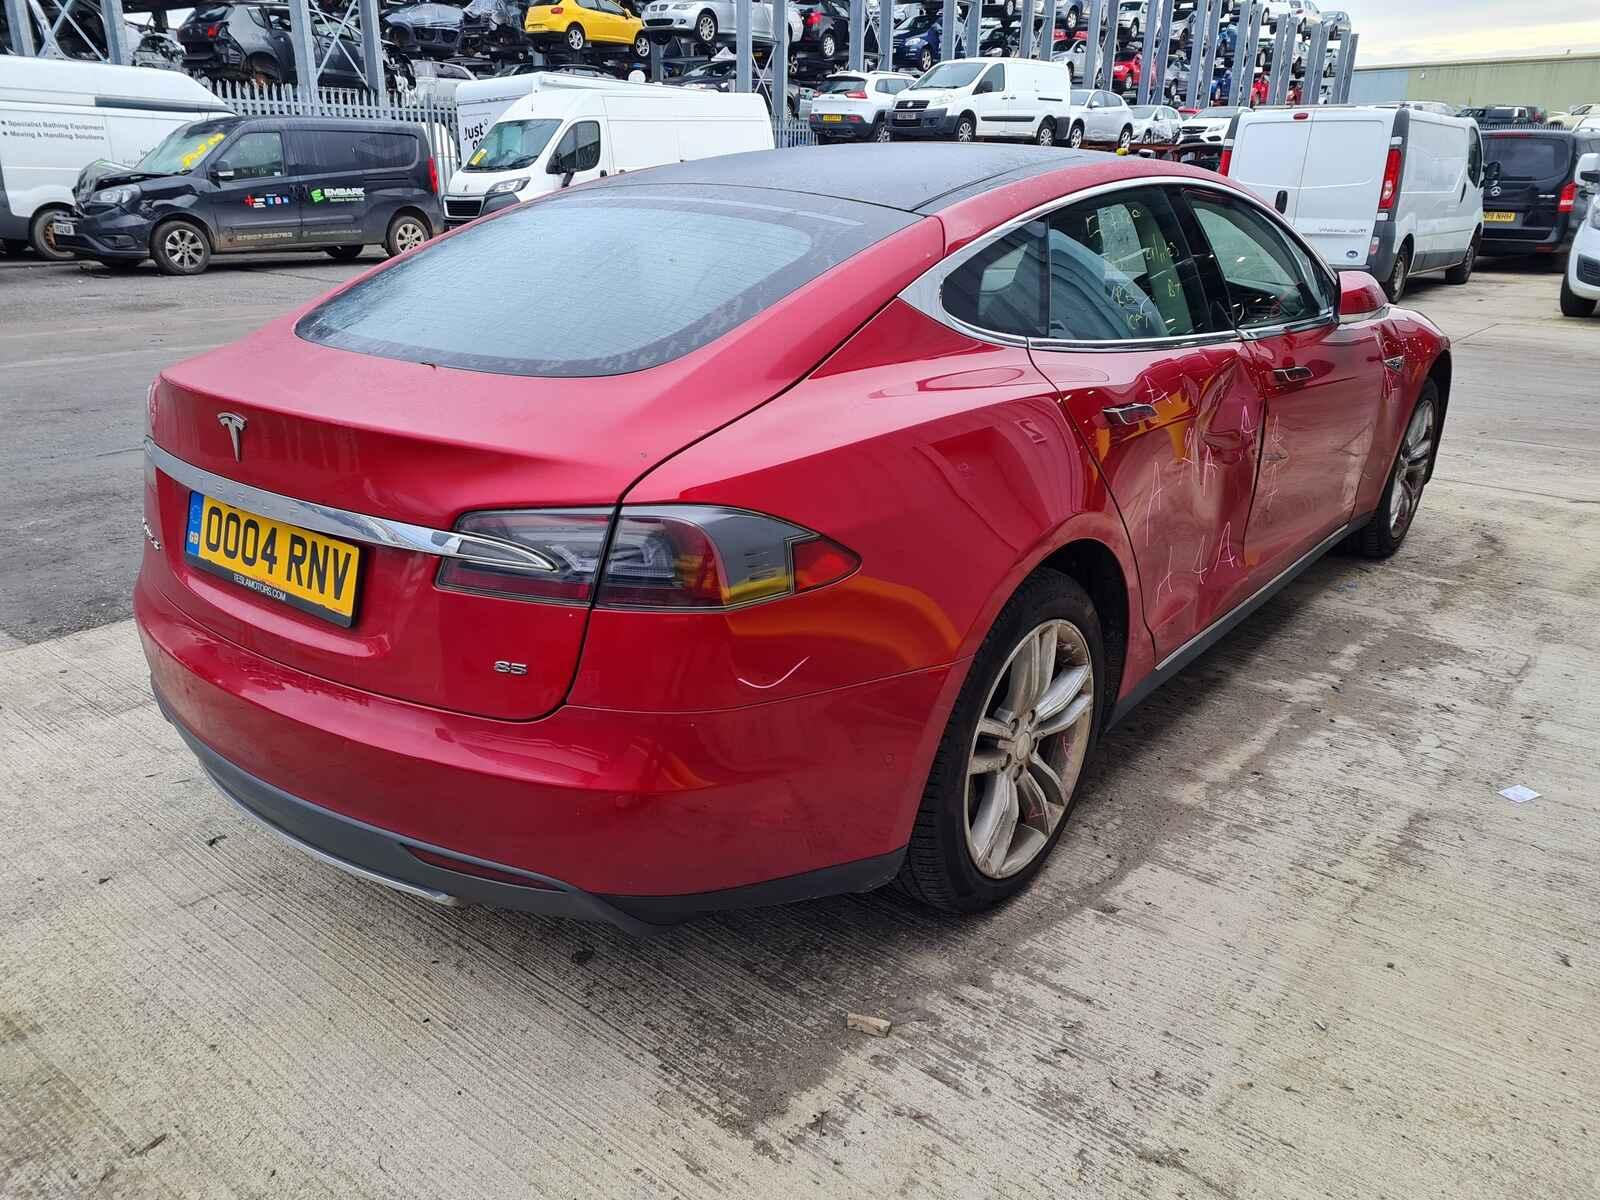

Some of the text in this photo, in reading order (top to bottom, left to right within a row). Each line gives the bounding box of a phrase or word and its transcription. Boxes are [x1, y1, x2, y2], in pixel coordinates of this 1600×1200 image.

[7, 120, 104, 131] Specialist Bathing Equipment
[463, 122, 484, 141] Just
[43, 132, 73, 140] Handling
[324, 187, 365, 198] EMBARK
[286, 533, 352, 601] RNV
[233, 573, 287, 601] TESLAMOTORS.COM
